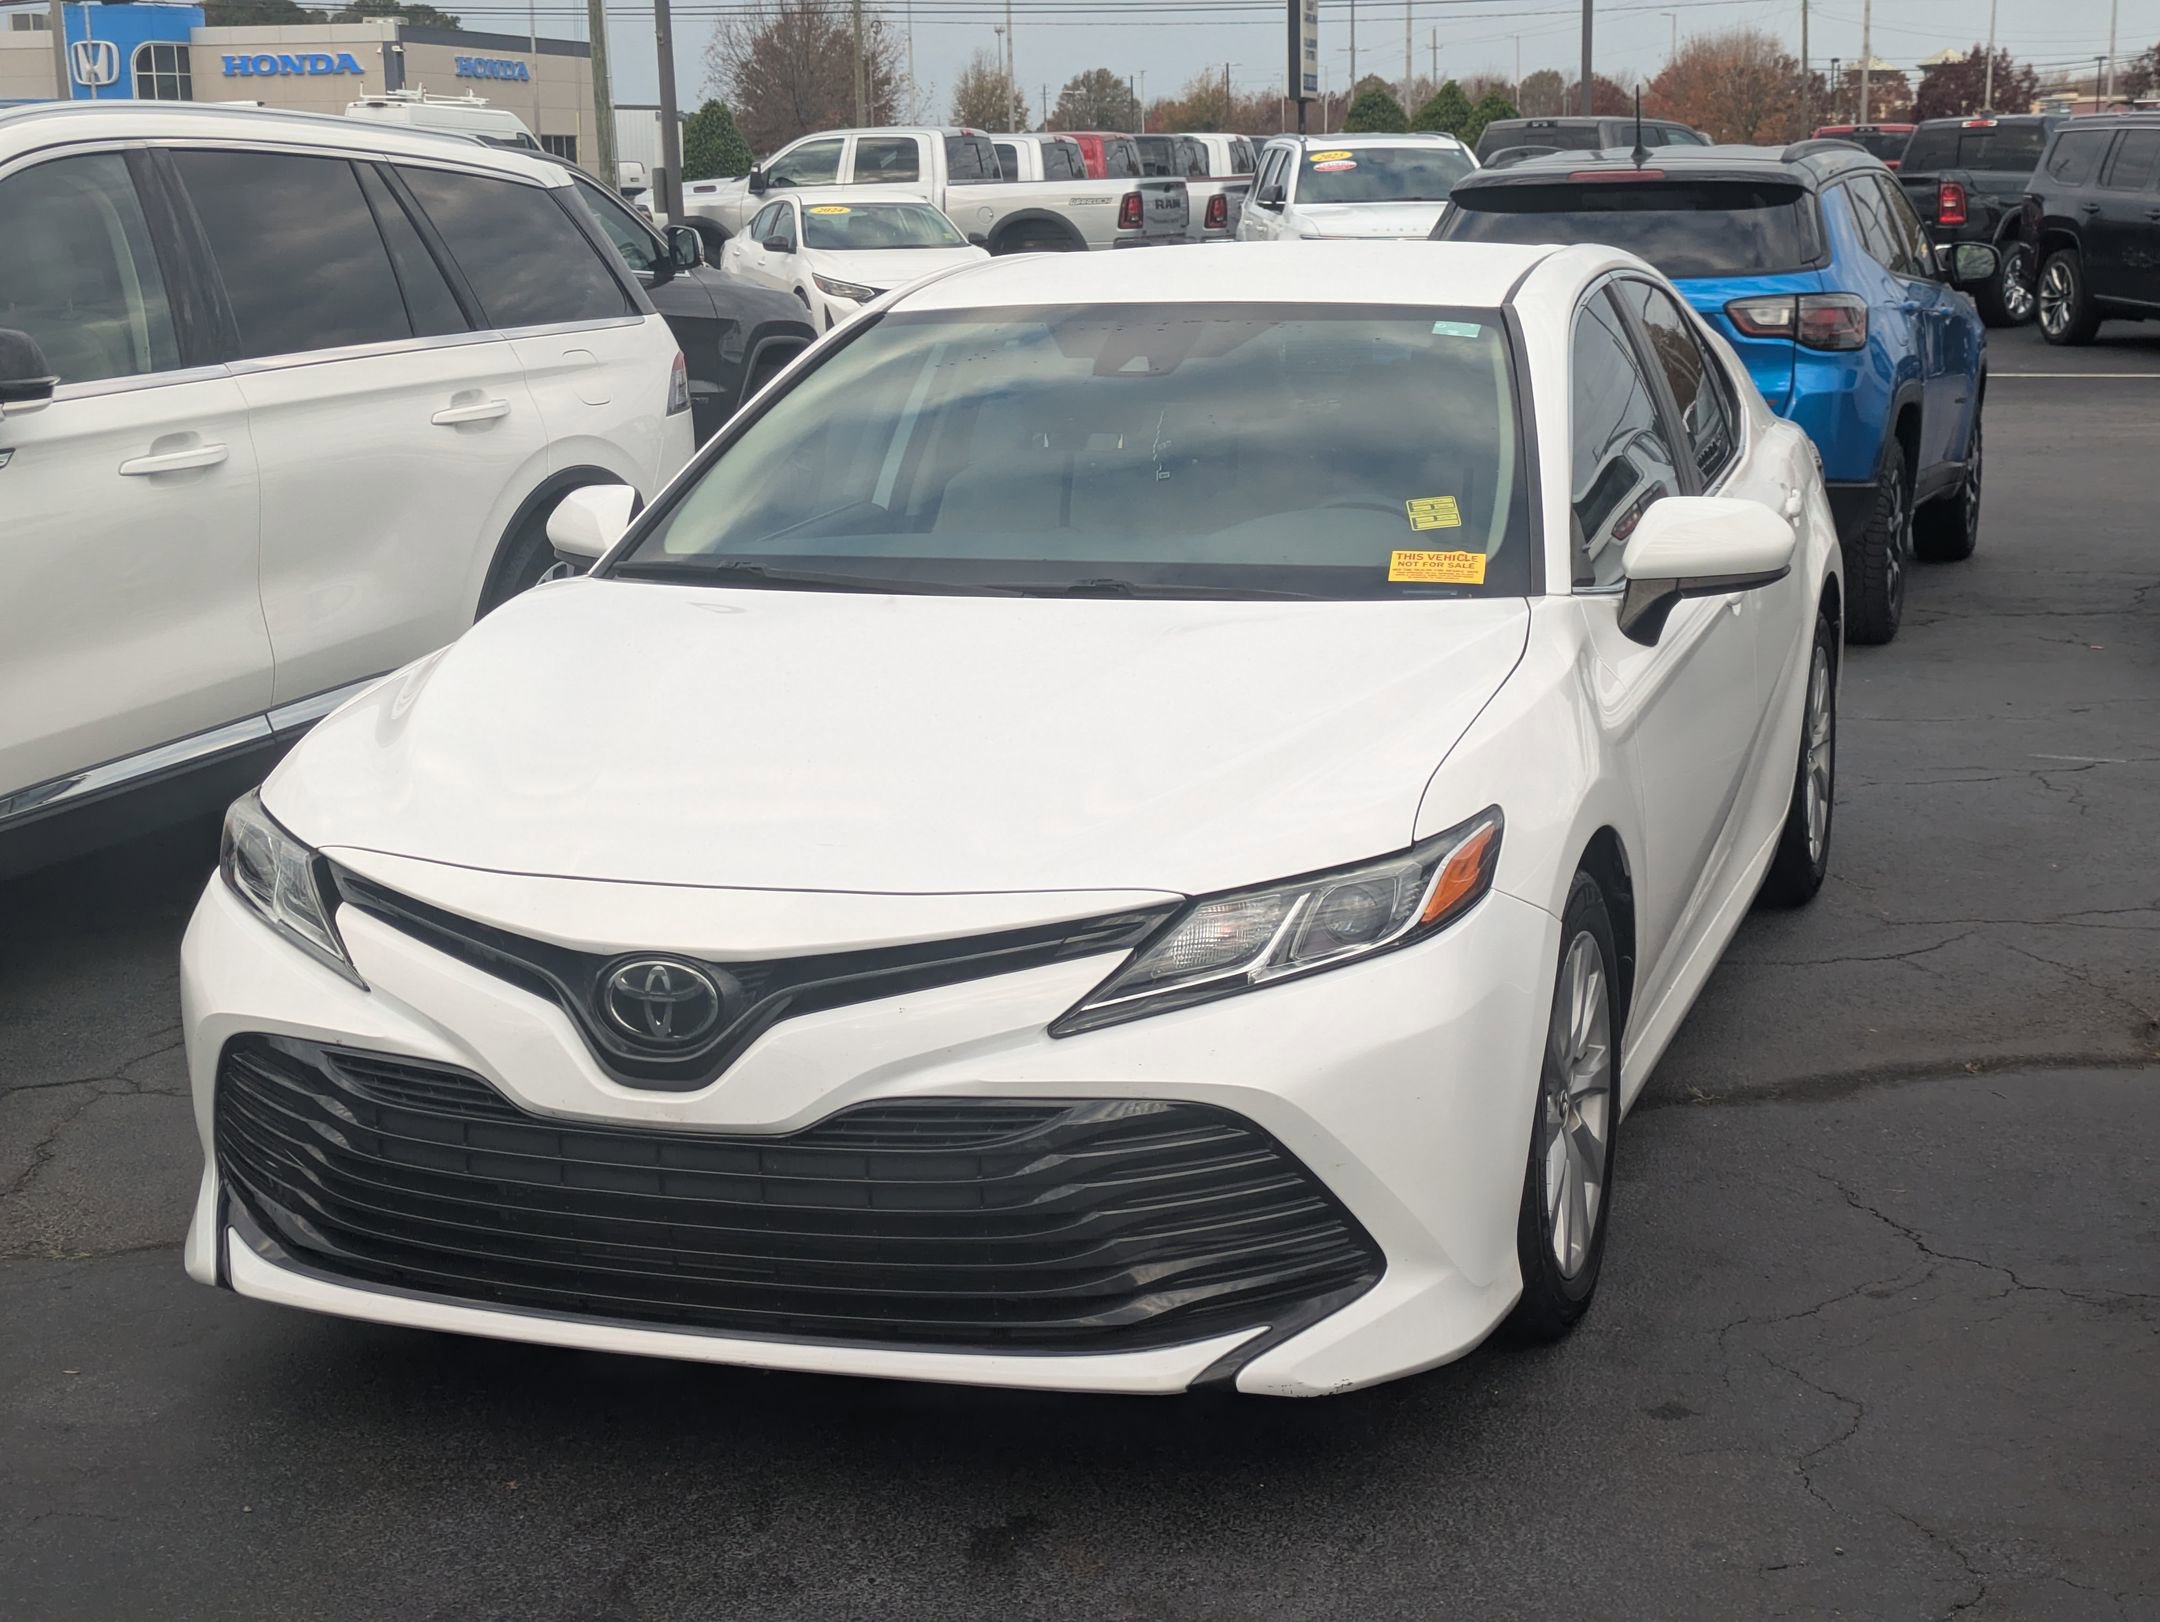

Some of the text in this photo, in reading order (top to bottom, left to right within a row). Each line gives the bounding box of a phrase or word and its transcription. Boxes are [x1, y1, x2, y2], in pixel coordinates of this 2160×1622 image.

[222, 53, 365, 77] HONDA
[455, 56, 531, 81] HONDA
[1155, 199, 1181, 210] RAM
[1428, 553, 1479, 562] VEHICLE
